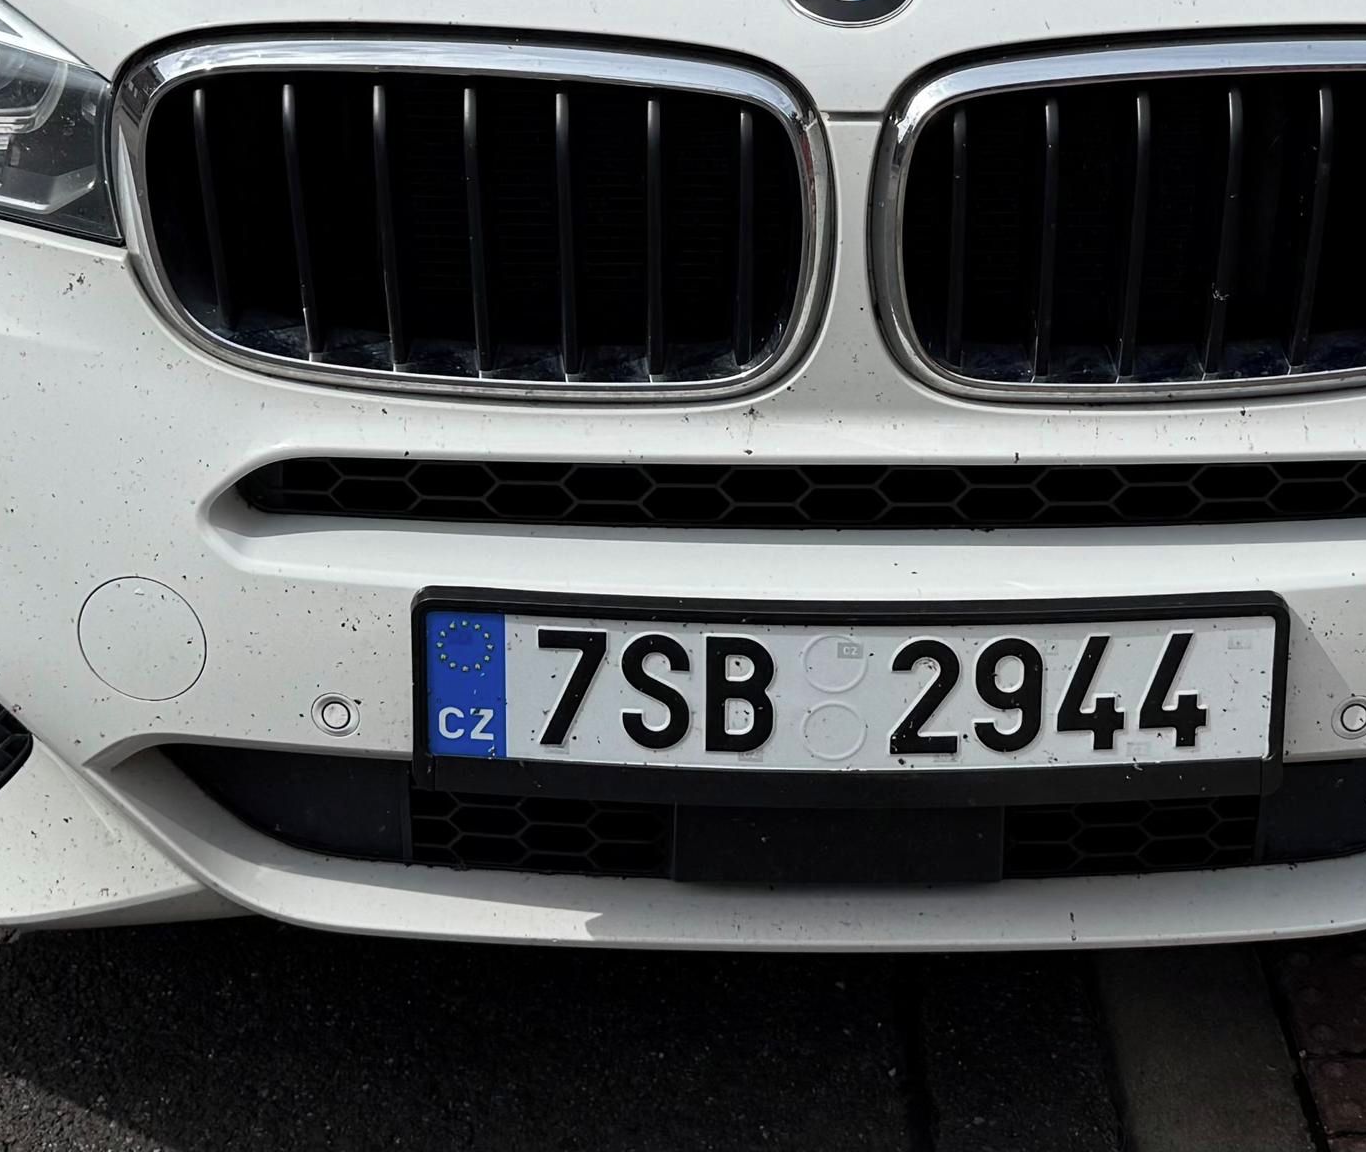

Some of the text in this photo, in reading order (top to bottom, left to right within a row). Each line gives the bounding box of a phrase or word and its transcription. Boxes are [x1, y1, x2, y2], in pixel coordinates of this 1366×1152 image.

[438, 706, 495, 740] CZ
[537, 628, 1208, 755] 7SB 2944
